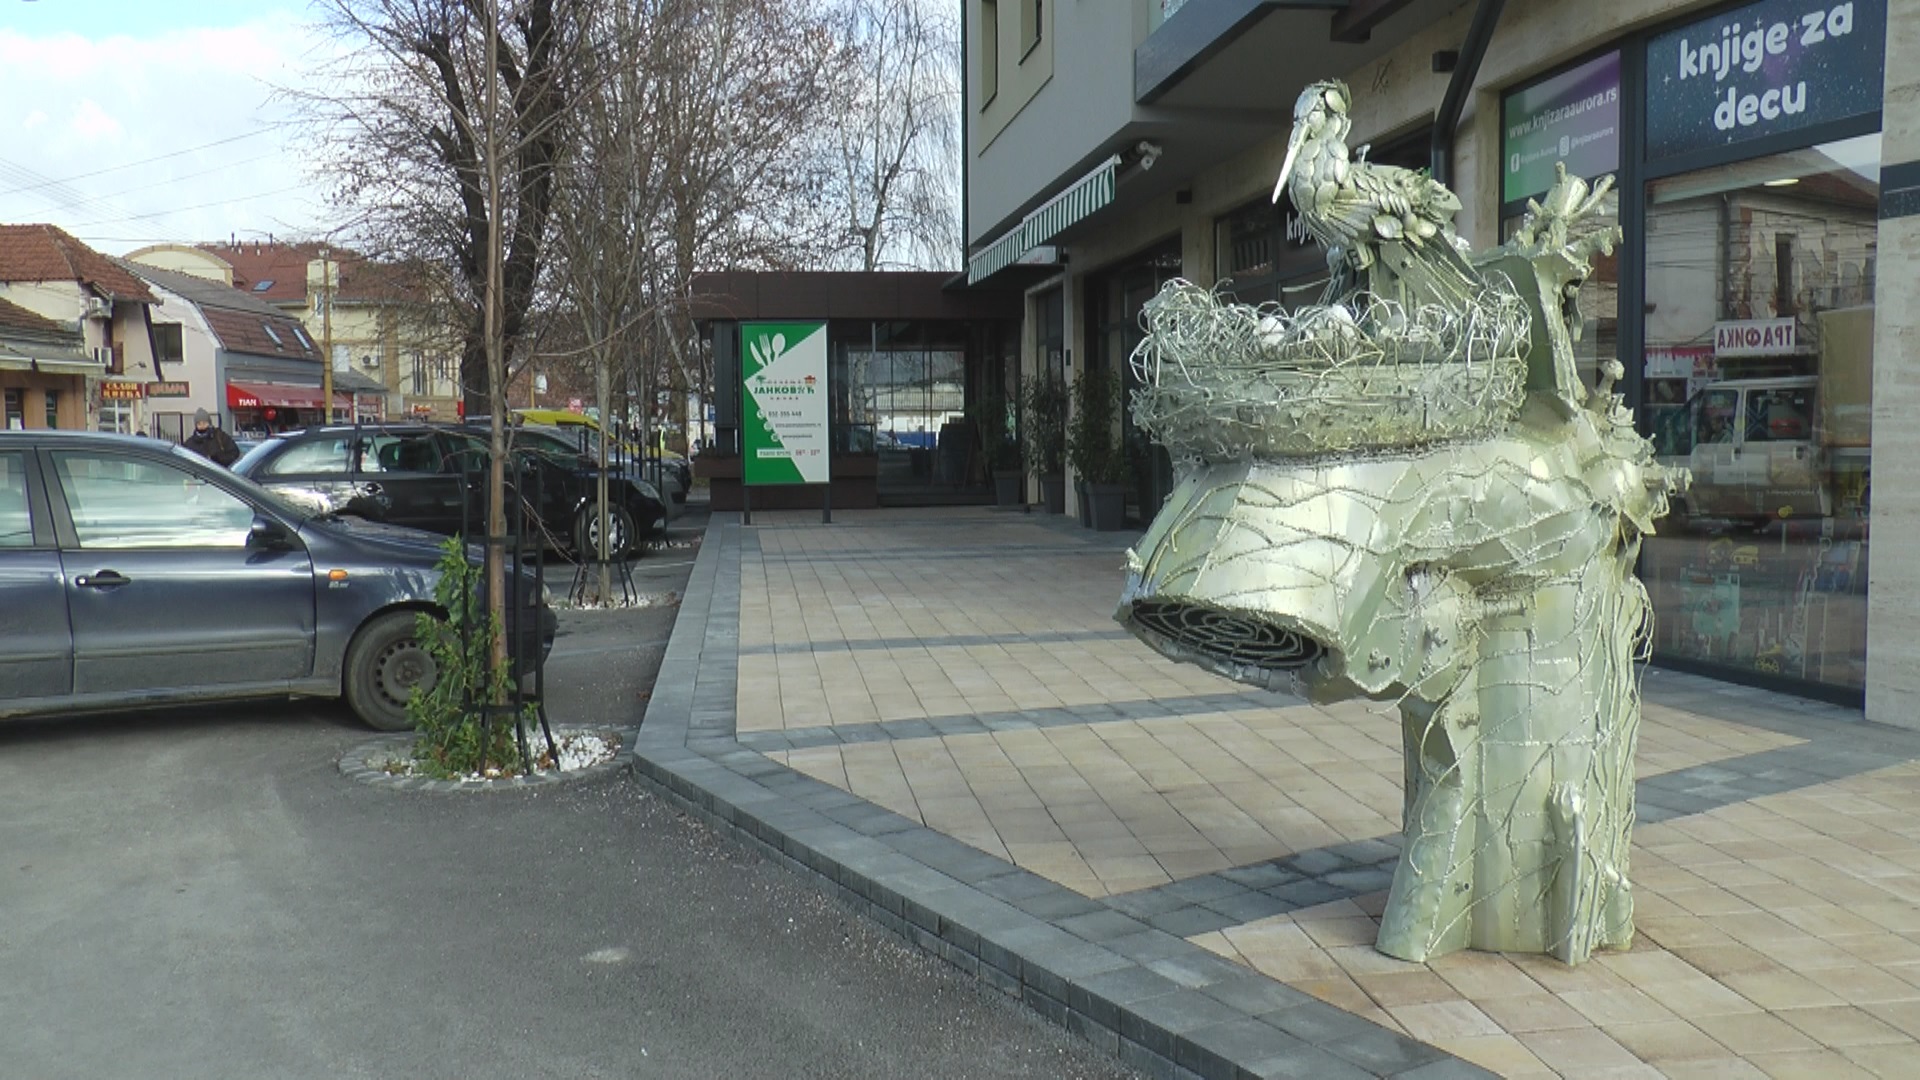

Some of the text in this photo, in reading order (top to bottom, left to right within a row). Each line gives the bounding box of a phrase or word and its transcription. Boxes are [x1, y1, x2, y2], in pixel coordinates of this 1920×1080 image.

[1680, 2, 1853, 81] knjige za
[1509, 87, 1617, 139] www.knjizaraaurora.rs
[1714, 81, 1806, 130] decu
